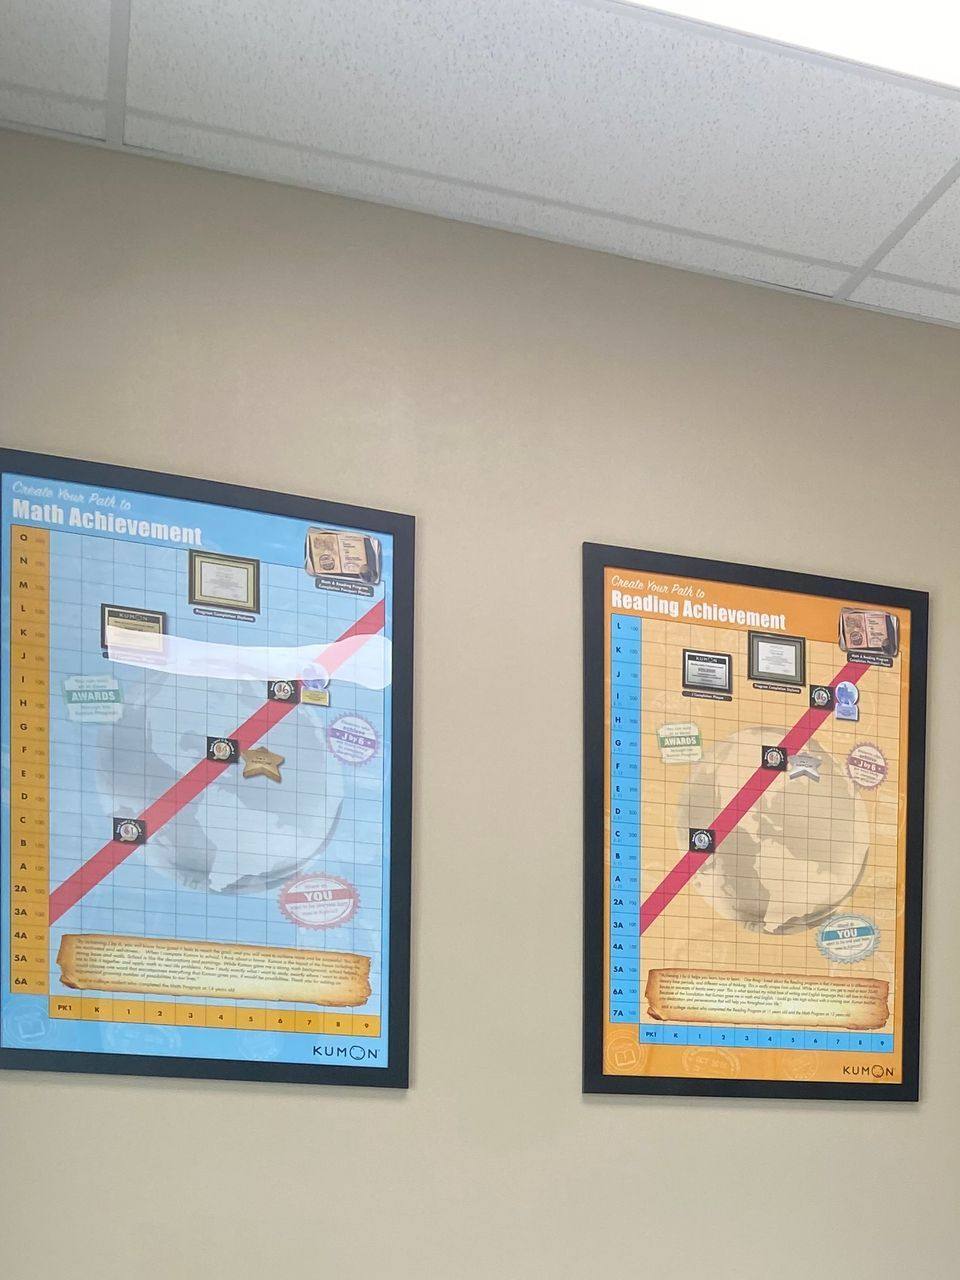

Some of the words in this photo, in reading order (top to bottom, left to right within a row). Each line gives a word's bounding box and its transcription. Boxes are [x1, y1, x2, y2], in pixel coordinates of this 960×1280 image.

[12, 480, 54, 498] Create
[57, 487, 85, 503] Your
[88, 492, 116, 508] Path
[119, 499, 132, 511] to
[12, 498, 64, 525] Math
[69, 507, 202, 545] Achievement
[611, 575, 644, 591] Create
[647, 578, 669, 594] Your
[671, 583, 694, 597] Path
[695, 588, 705, 599] to
[611, 589, 679, 618] Reading
[682, 599, 786, 630] Achievement
[71, 691, 116, 701] AWARDS
[348, 735, 358, 744] by
[664, 736, 697, 746] AWARDS
[303, 890, 333, 902] YOU
[837, 928, 858, 939] YOU
[313, 1045, 378, 1061] KUMON
[843, 1064, 894, 1079] KUMON
